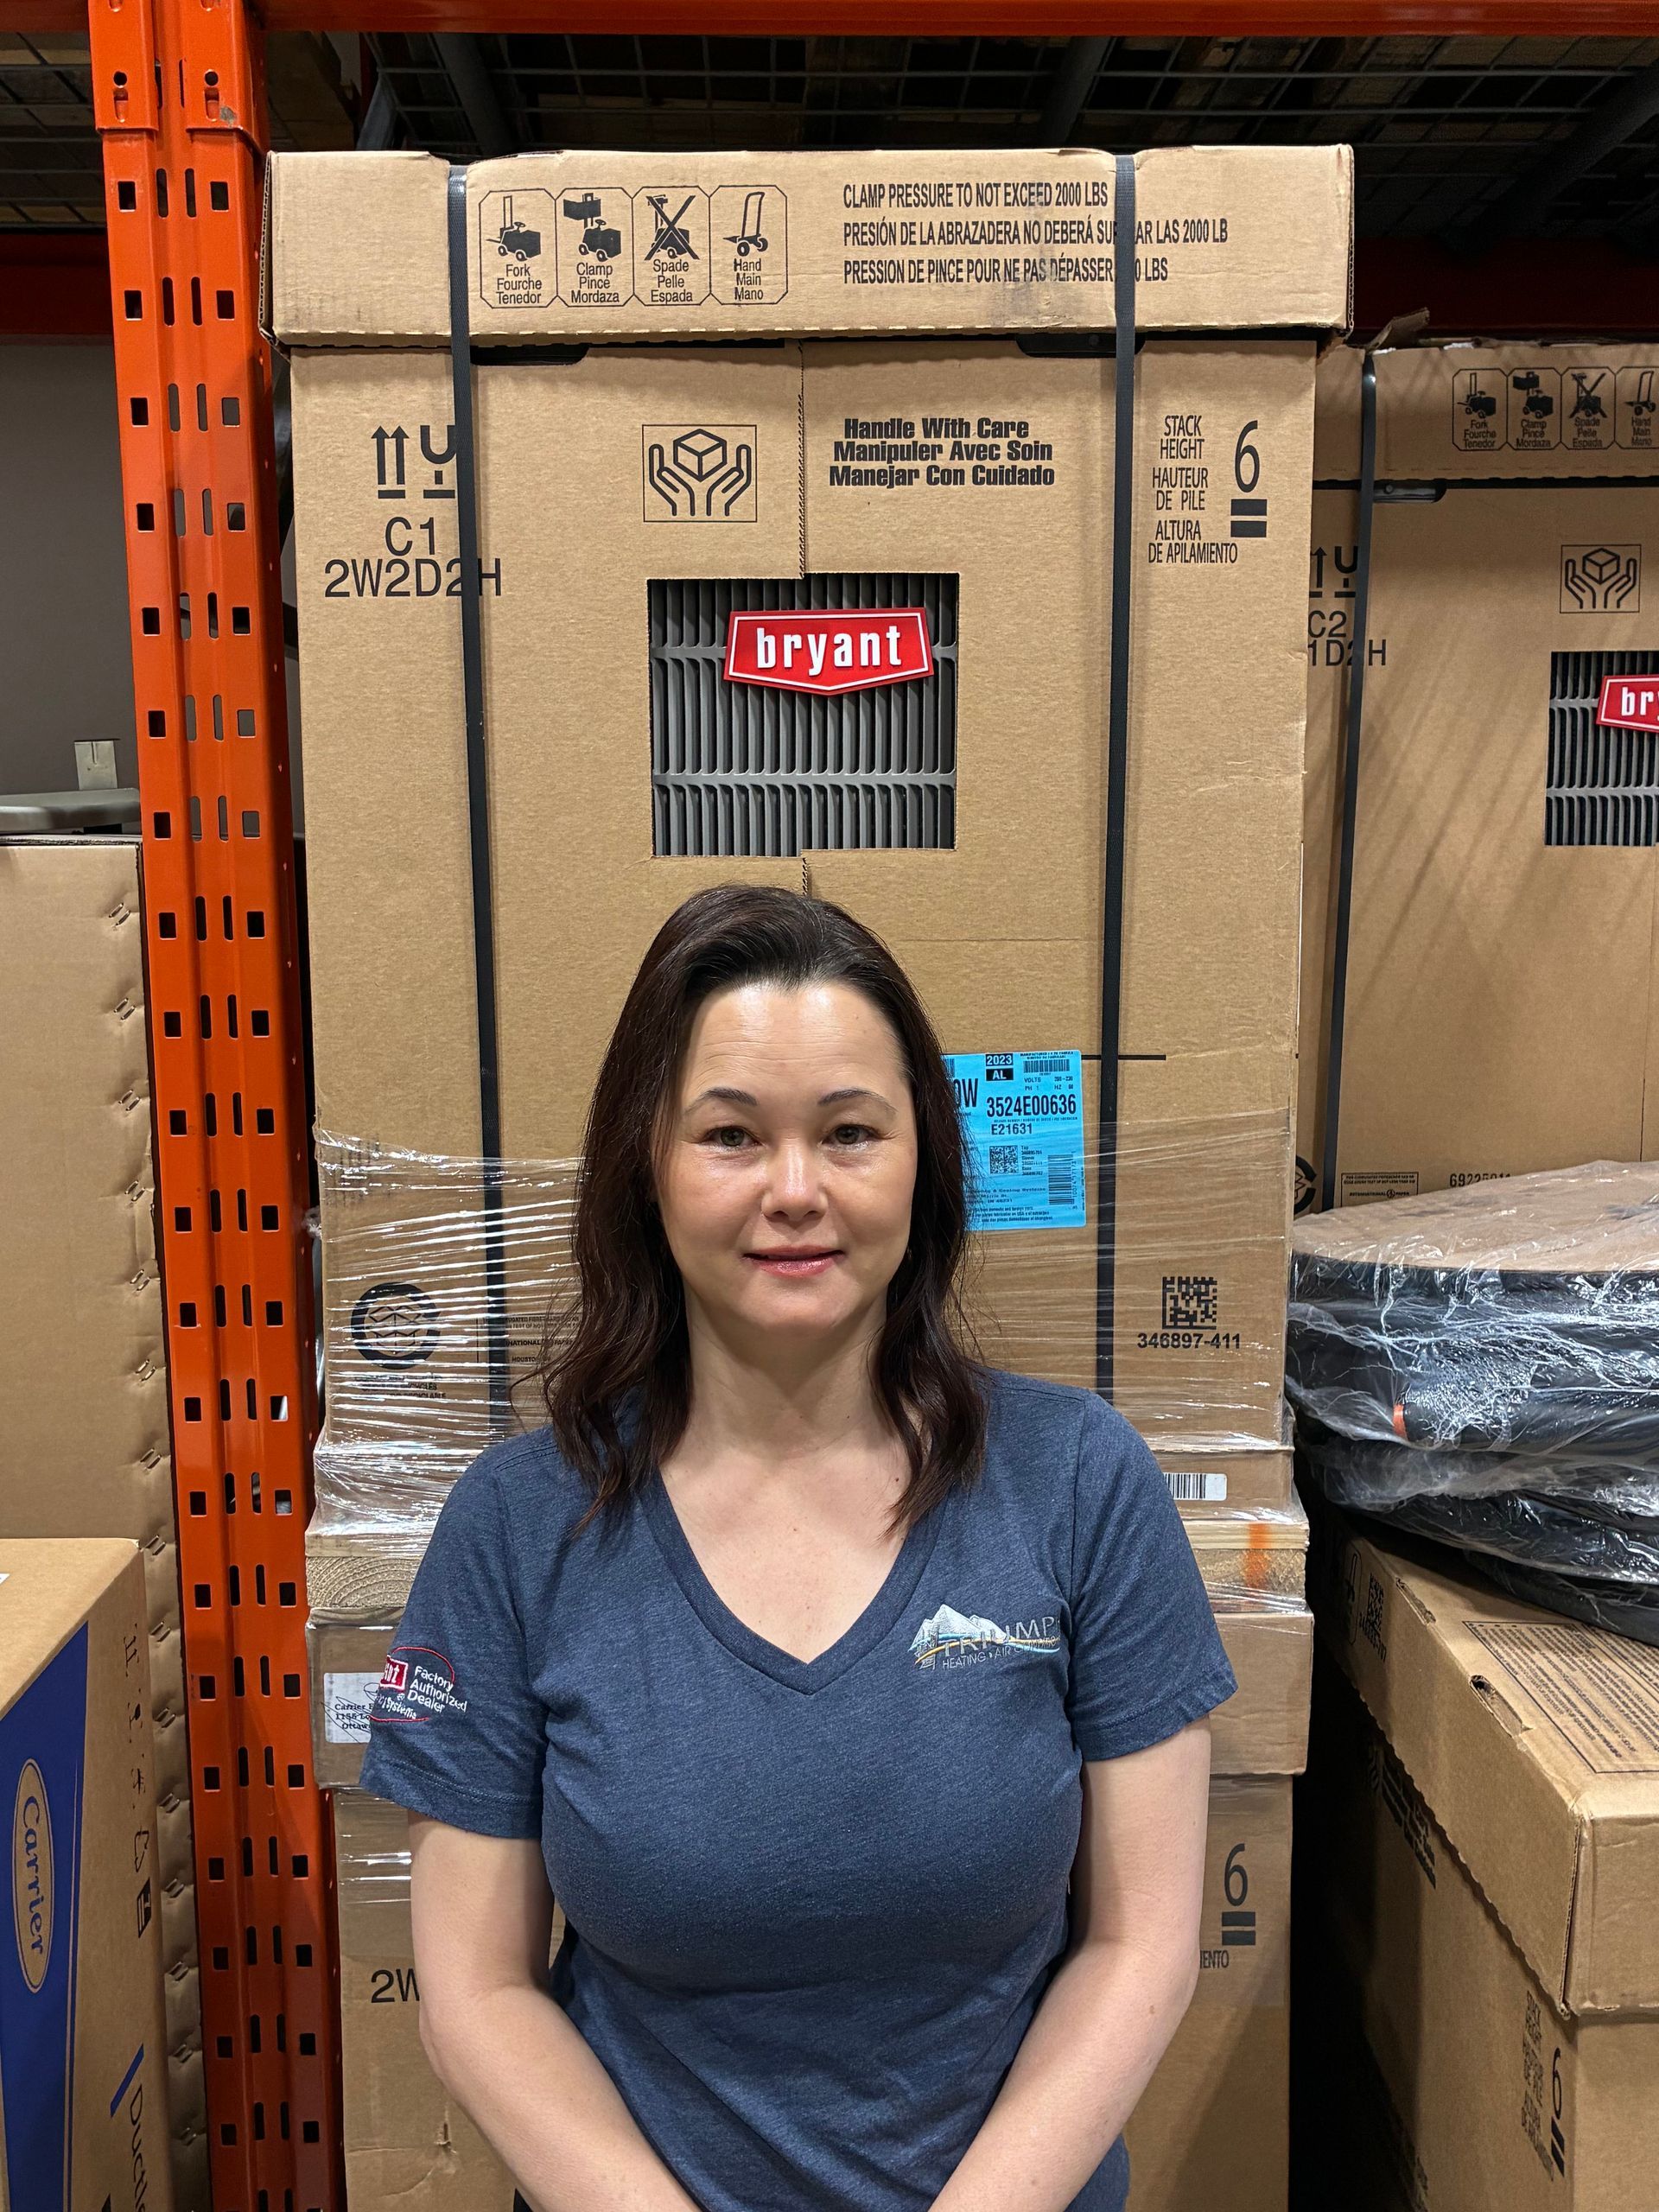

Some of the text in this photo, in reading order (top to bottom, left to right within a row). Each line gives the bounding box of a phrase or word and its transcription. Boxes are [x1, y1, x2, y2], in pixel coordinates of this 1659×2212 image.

[843, 181, 1108, 208] CLAMP PRESSURE TO NOT EXCEED 2000 LBS
[843, 216, 896, 246] PRESIÓN
[900, 221, 917, 246] DE
[919, 221, 936, 245] LA
[938, 220, 1020, 245] ABRAZADERA
[1024, 220, 1040, 244] NO
[1044, 214, 1094, 245] DEBERÁ
[1156, 219, 1179, 244] LAS
[1183, 219, 1209, 243] 2000
[1212, 218, 1228, 243] LB
[505, 264, 531, 276] Fork
[576, 263, 613, 277] Clamp
[653, 259, 689, 274] Spade
[734, 258, 762, 272] Hand
[843, 259, 904, 284] PRESSION
[908, 259, 925, 283] DE
[928, 258, 963, 283] PINCE
[967, 258, 1001, 283] POUR
[1004, 258, 1020, 283] NE
[1024, 258, 1046, 283] PAS
[1050, 252, 1113, 283] DÉPASSER
[1145, 257, 1168, 282] LBS
[497, 278, 542, 290] Fourche
[579, 276, 610, 289] Pince
[658, 275, 684, 288] Pelle
[736, 273, 761, 286] Main
[496, 291, 541, 303] Tenedor
[571, 289, 620, 302] Mordaza
[651, 289, 693, 304] Espada
[734, 287, 763, 300] Mano
[844, 416, 1029, 439] Handle With Care
[1164, 415, 1202, 437] STACK
[834, 440, 1052, 464] Manipuler Avec Soin
[1160, 438, 1205, 460] HEIGHT
[1235, 419, 1260, 493] 6
[830, 464, 1055, 489] Manejar Con Cuidado
[1152, 467, 1208, 488] HAUTEUR
[1156, 490, 1205, 511] DE PILE
[385, 517, 435, 556] C1
[1155, 520, 1201, 540] ALTURA
[1148, 543, 1237, 563] DE APILAMIENTO
[756, 625, 902, 677] bryant
[986, 1054, 1013, 1065] 2023
[992, 1070, 1007, 1080] AL
[986, 1094, 1077, 1117] 3524E00636
[991, 1123, 1033, 1135] E21631
[1137, 1332, 1240, 1350] 346897-411
[942, 1614, 1060, 1657] TRIUMP
[942, 1645, 1012, 1670] HEATING AIR
[414, 1665, 454, 1693] Factory
[407, 1689, 446, 1713] Dealer
[410, 1678, 467, 1713] Authorized
[23, 1796, 44, 1955] Carrier
[1224, 1843, 1249, 1907] 6
